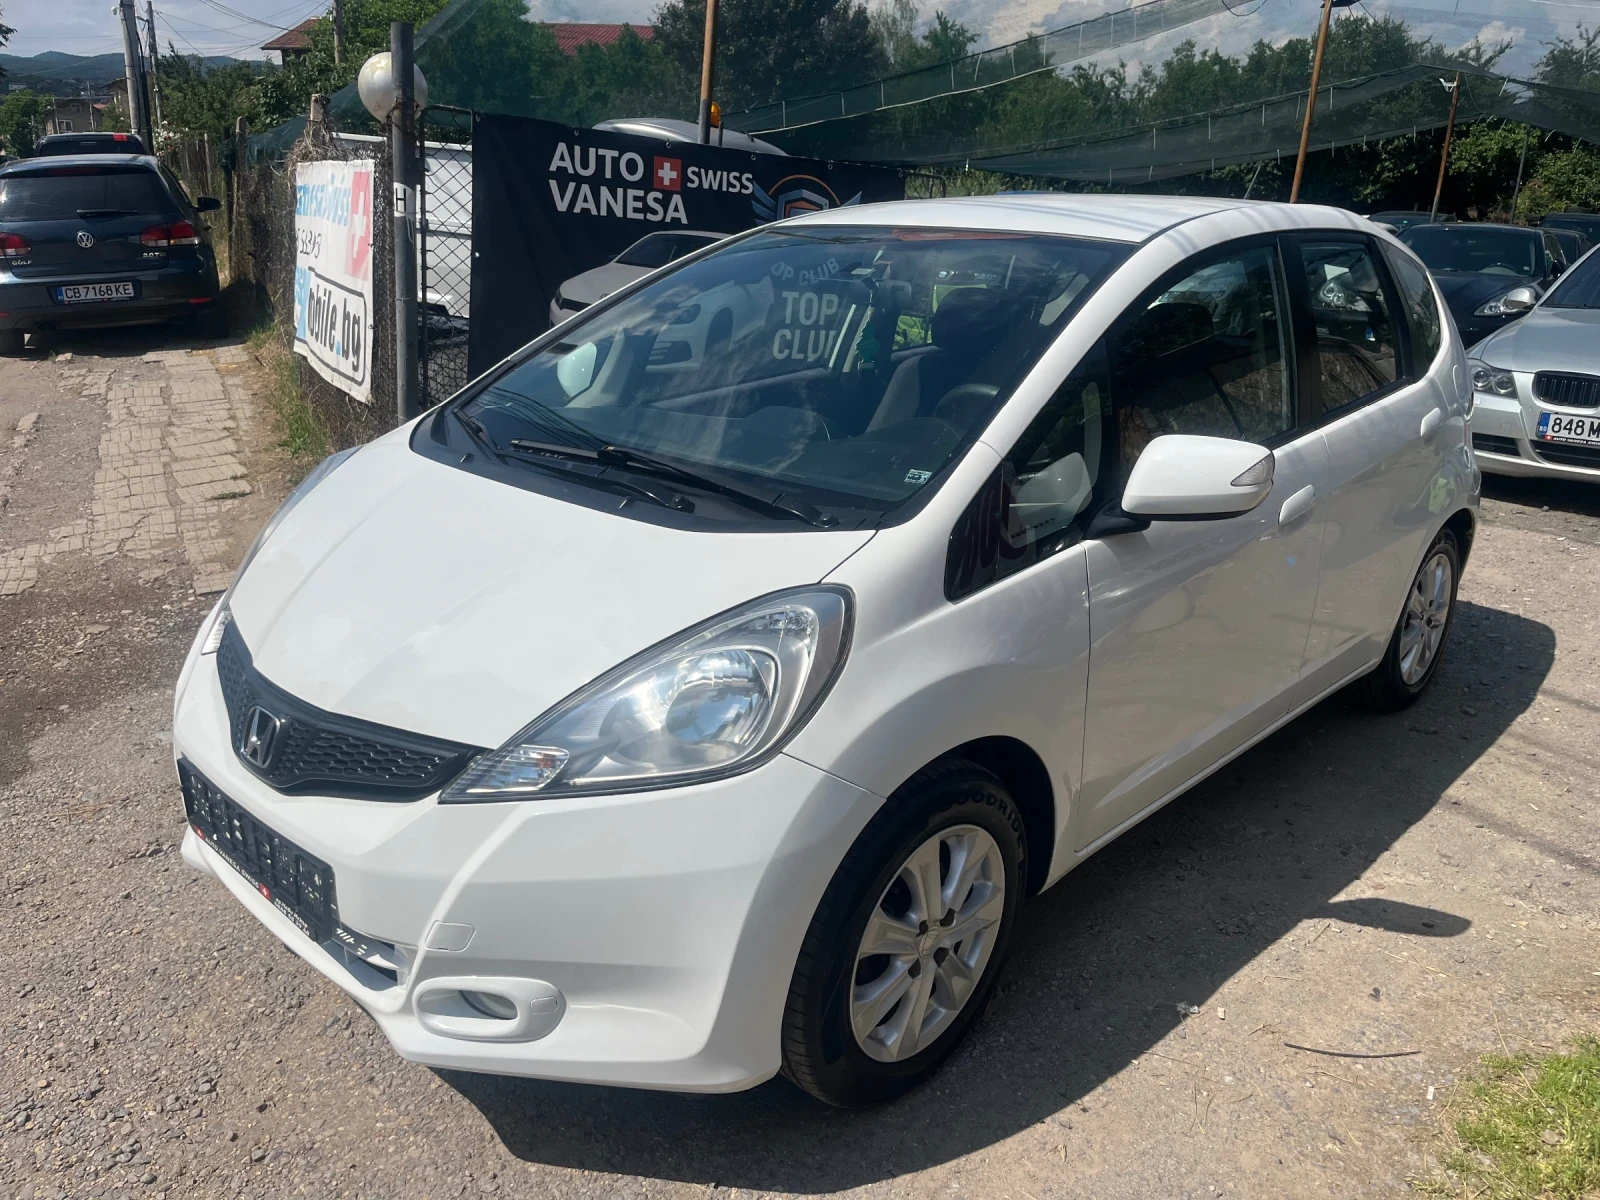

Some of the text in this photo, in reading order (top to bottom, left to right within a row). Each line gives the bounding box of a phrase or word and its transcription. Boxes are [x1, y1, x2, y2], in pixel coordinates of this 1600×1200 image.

[549, 142, 645, 182] AUTO
[686, 166, 754, 195] SWISS
[548, 179, 689, 225] VANESA
[781, 291, 840, 326] TOP
